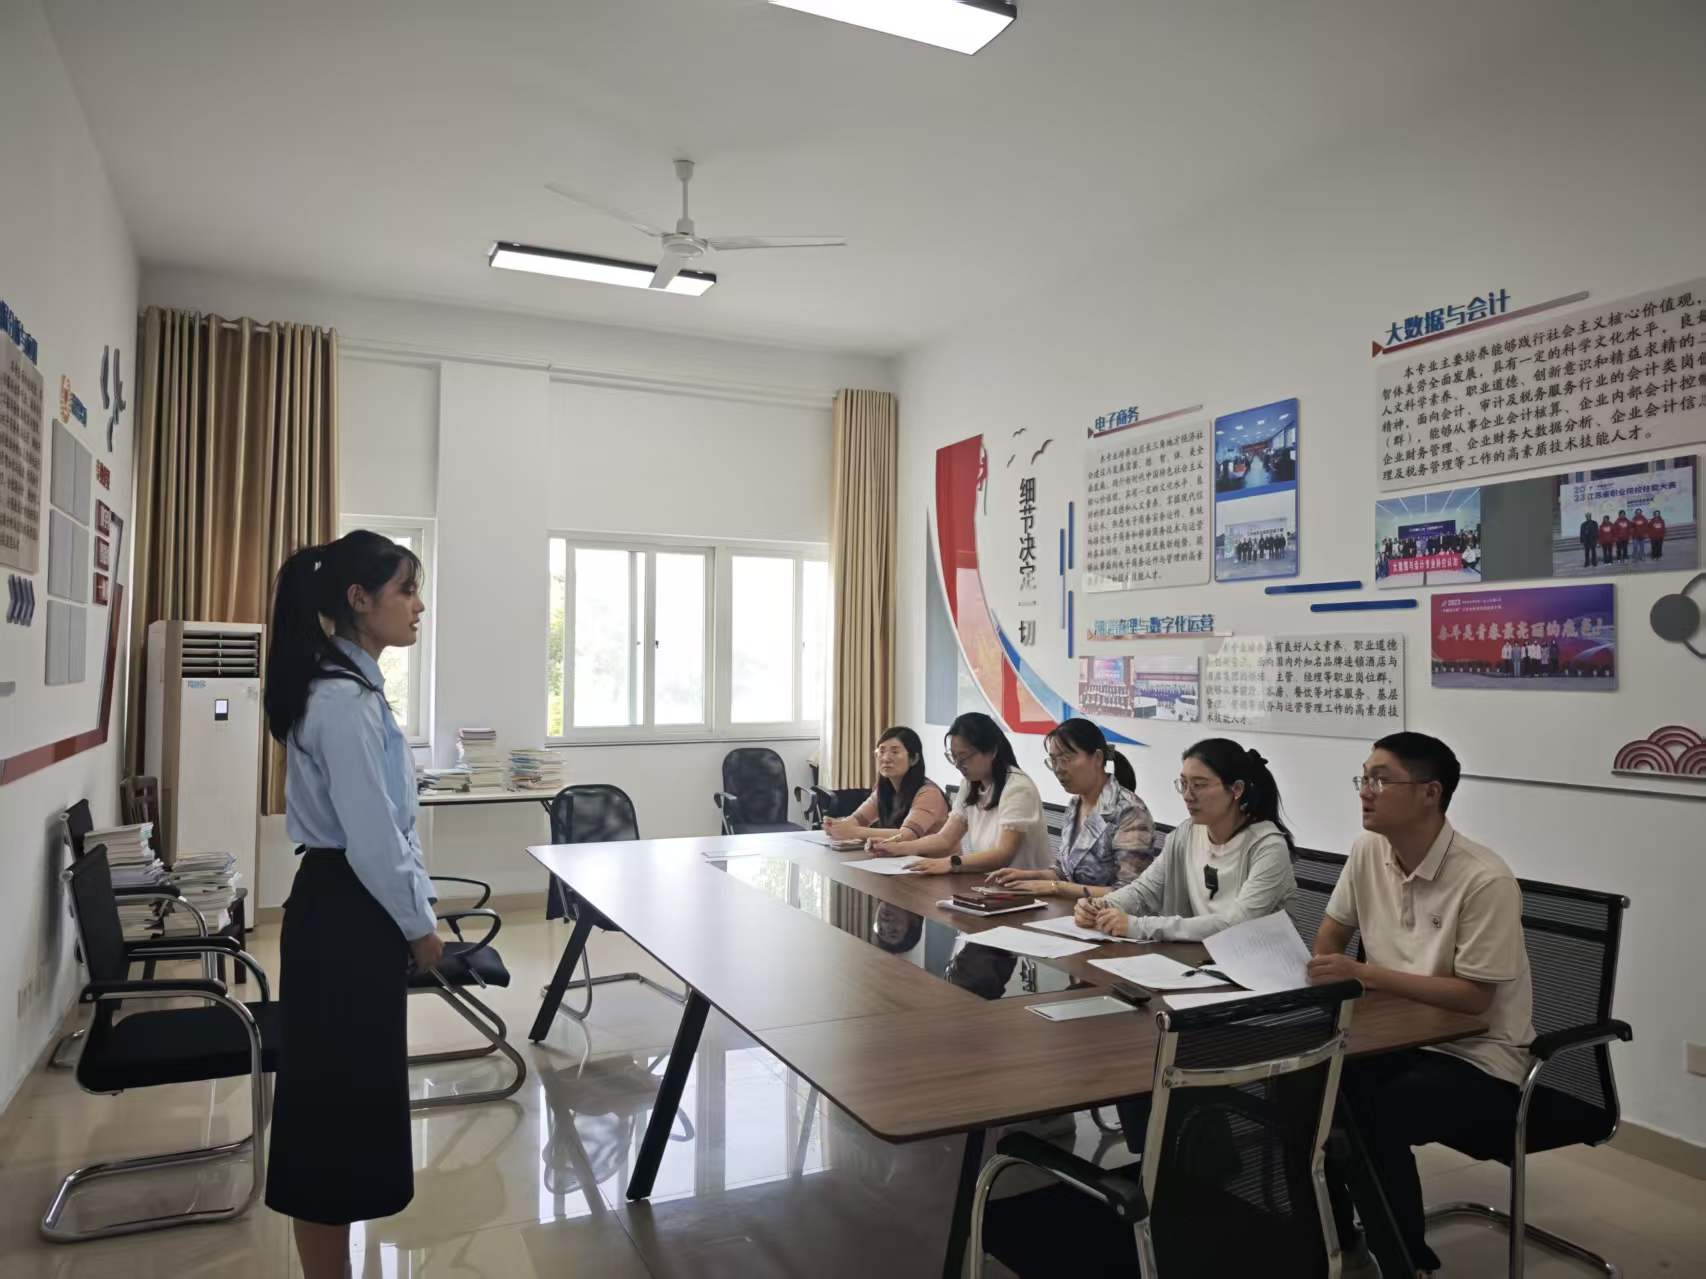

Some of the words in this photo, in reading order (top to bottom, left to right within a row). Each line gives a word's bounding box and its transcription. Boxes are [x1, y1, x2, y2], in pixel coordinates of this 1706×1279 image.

[1386, 289, 1511, 345] 大数据与会计
[1094, 406, 1139, 432] 电子商务
[1019, 477, 1036, 647] 细节决定一切
